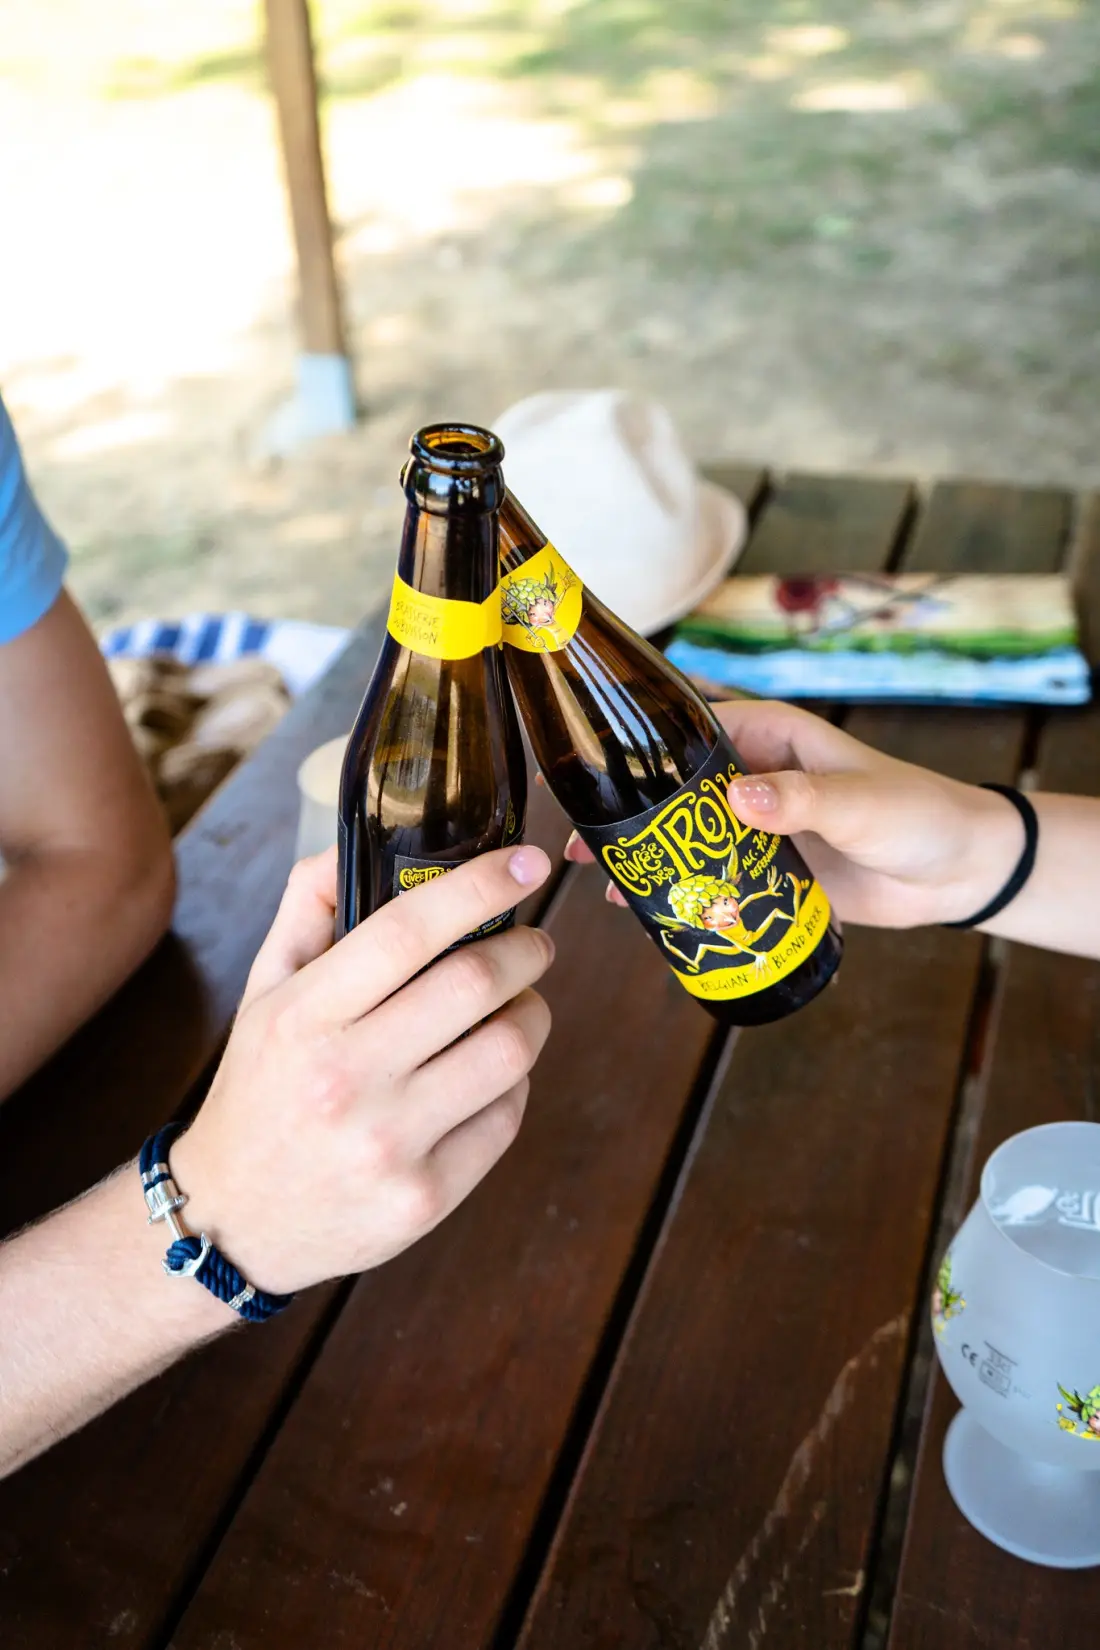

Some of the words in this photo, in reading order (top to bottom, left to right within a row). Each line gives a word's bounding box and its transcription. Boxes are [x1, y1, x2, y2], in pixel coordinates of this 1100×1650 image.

[617, 763, 752, 882] TROL
[696, 972, 749, 992] BELGIAN
[772, 935, 806, 970] BLOND
[804, 906, 822, 937] BEER
